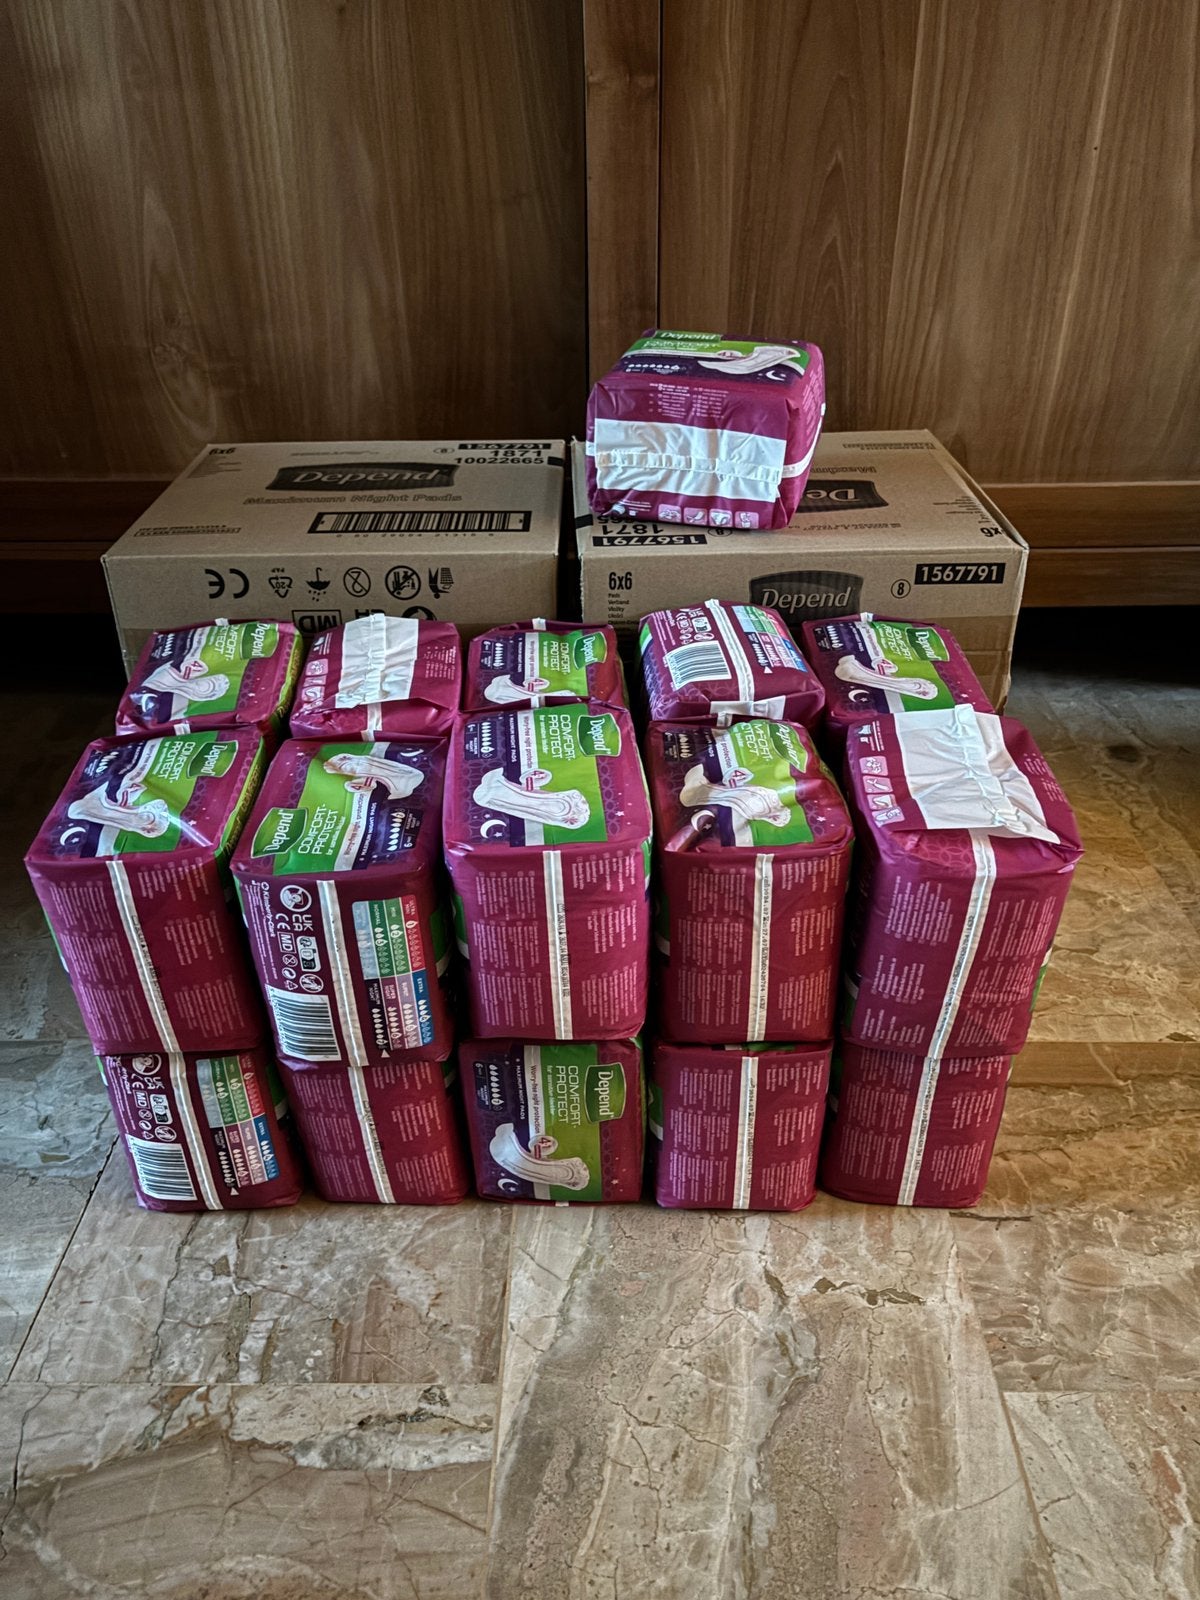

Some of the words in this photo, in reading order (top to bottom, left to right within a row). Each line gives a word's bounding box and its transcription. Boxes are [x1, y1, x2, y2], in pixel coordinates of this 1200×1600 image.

[292, 469, 441, 485] Depend
[602, 537, 700, 545] 1567791
[603, 525, 664, 535] 1871
[609, 572, 632, 590] 6x6
[921, 566, 998, 582] 1567791
[762, 586, 850, 614] Depend
[251, 623, 270, 657] Depend
[582, 636, 597, 662] Depend
[550, 641, 559, 671] PROTECT
[548, 714, 562, 758] PROTECT
[590, 719, 609, 751] Depend
[158, 741, 181, 779] PROTECT
[201, 745, 227, 776] Depend
[264, 812, 294, 851] Depend
[311, 810, 338, 854] PROTECT
[292, 915, 303, 932] CA
[302, 914, 313, 931] UK
[280, 934, 293, 951] MD
[136, 1092, 147, 1107] MD
[556, 1065, 568, 1123] PROTECT
[568, 1065, 581, 1128] COMFORT-
[594, 1070, 613, 1116] Depend
[533, 1106, 541, 1134] protection
